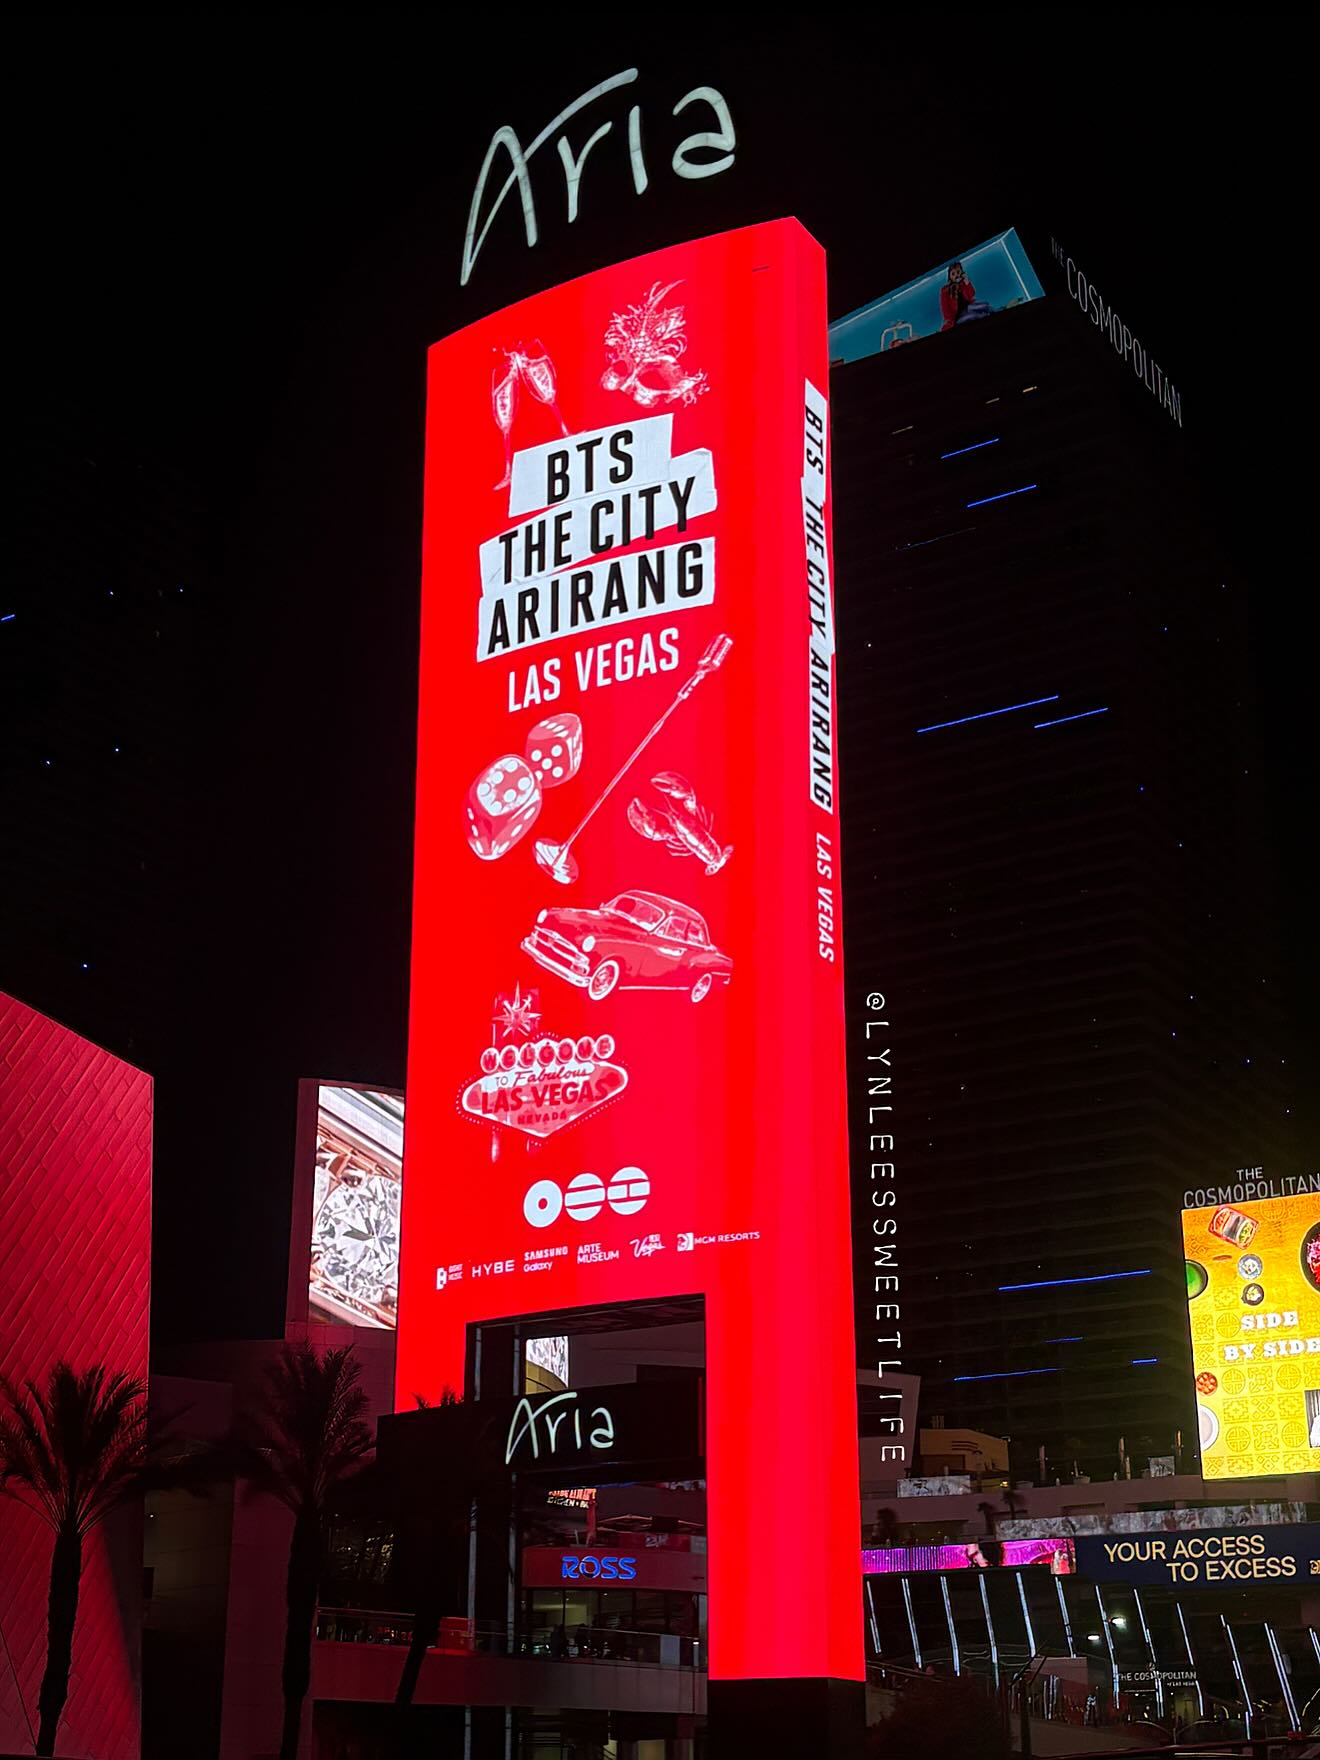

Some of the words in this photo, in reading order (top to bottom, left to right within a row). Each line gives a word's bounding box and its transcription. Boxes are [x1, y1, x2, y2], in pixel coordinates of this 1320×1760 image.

[460, 67, 736, 286] Aria
[1066, 257, 1183, 429] COSMOPOLITAN
[805, 405, 824, 476] BTS
[547, 430, 633, 506] BTS
[499, 510, 573, 585] THE
[590, 476, 696, 554] CITY
[805, 496, 824, 559] THE
[487, 542, 704, 655] ARIRANG
[806, 558, 826, 638] CITY
[508, 657, 561, 713] LAS
[575, 627, 679, 691] VEGAS
[811, 647, 831, 815] ARIRANG
[816, 832, 832, 880] LAS
[817, 887, 834, 963] VEGAS
[481, 1035, 614, 1073] WELCOME
[495, 1076, 508, 1087] TO
[513, 1066, 592, 1088] Fabulous
[481, 1087, 524, 1114] LAS
[531, 1078, 608, 1107] VEGAS
[517, 1110, 567, 1125] NEVADA
[1183, 1173, 1320, 1208] COSMOPOLITAN
[1236, 1166, 1263, 1181] THE
[524, 1246, 568, 1261] SAMSUNG
[578, 1242, 601, 1254] ARTE
[717, 1231, 760, 1243] RESORTS
[472, 1259, 515, 1278] HYBE
[577, 1250, 619, 1264] MUSEUM
[1241, 1311, 1298, 1331] SIDE
[1223, 1343, 1255, 1362] BY
[1263, 1337, 1320, 1358] SIDE
[505, 1391, 615, 1465] Aria
[1104, 1540, 1166, 1563] YOUR
[1172, 1534, 1266, 1560] ACCESS
[561, 1556, 637, 1580] ROSS
[1166, 1562, 1199, 1583] TO
[1205, 1555, 1297, 1581] EXCESS
